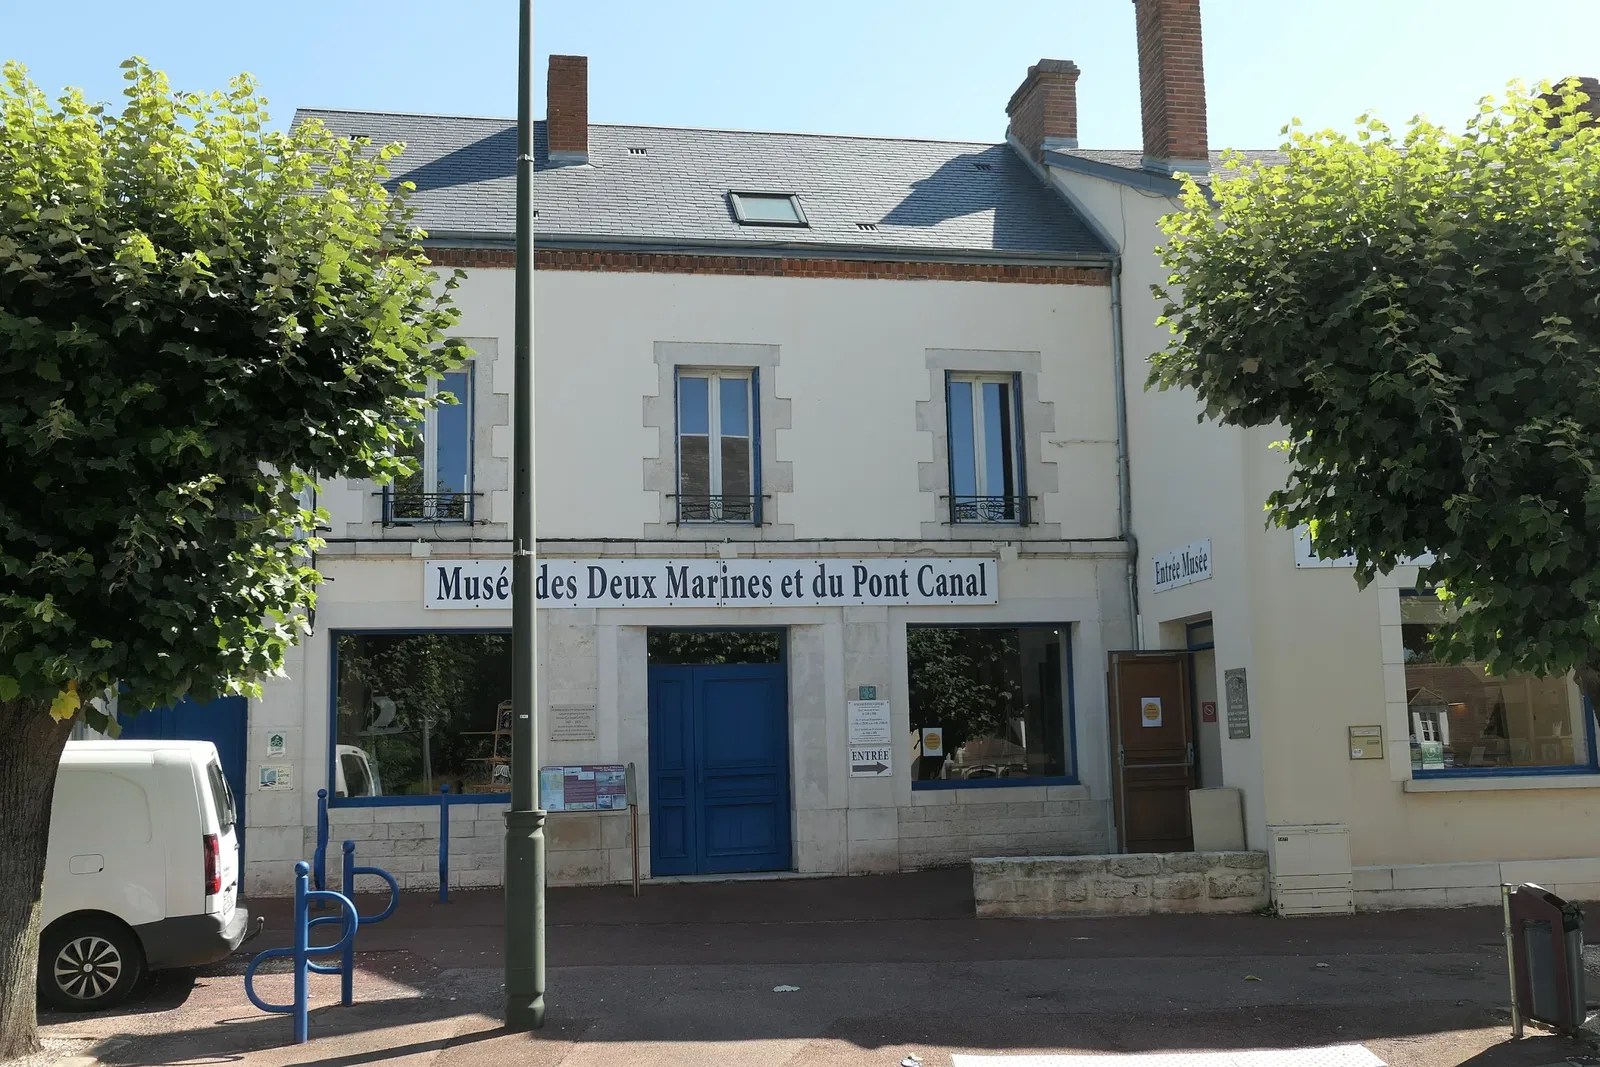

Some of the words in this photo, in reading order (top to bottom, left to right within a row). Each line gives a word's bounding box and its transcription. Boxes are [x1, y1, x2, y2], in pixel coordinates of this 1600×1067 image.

[437, 566, 513, 600] Musé
[536, 564, 577, 599] des
[586, 565, 657, 599] Deux
[665, 564, 773, 599] Marines
[781, 569, 804, 598] et
[812, 563, 844, 598] du
[852, 565, 909, 597] Pont
[917, 562, 987, 597] Canal
[1155, 556, 1180, 585] Entrée
[1182, 547, 1208, 578] Musée
[852, 749, 889, 761] ENTRÉE
